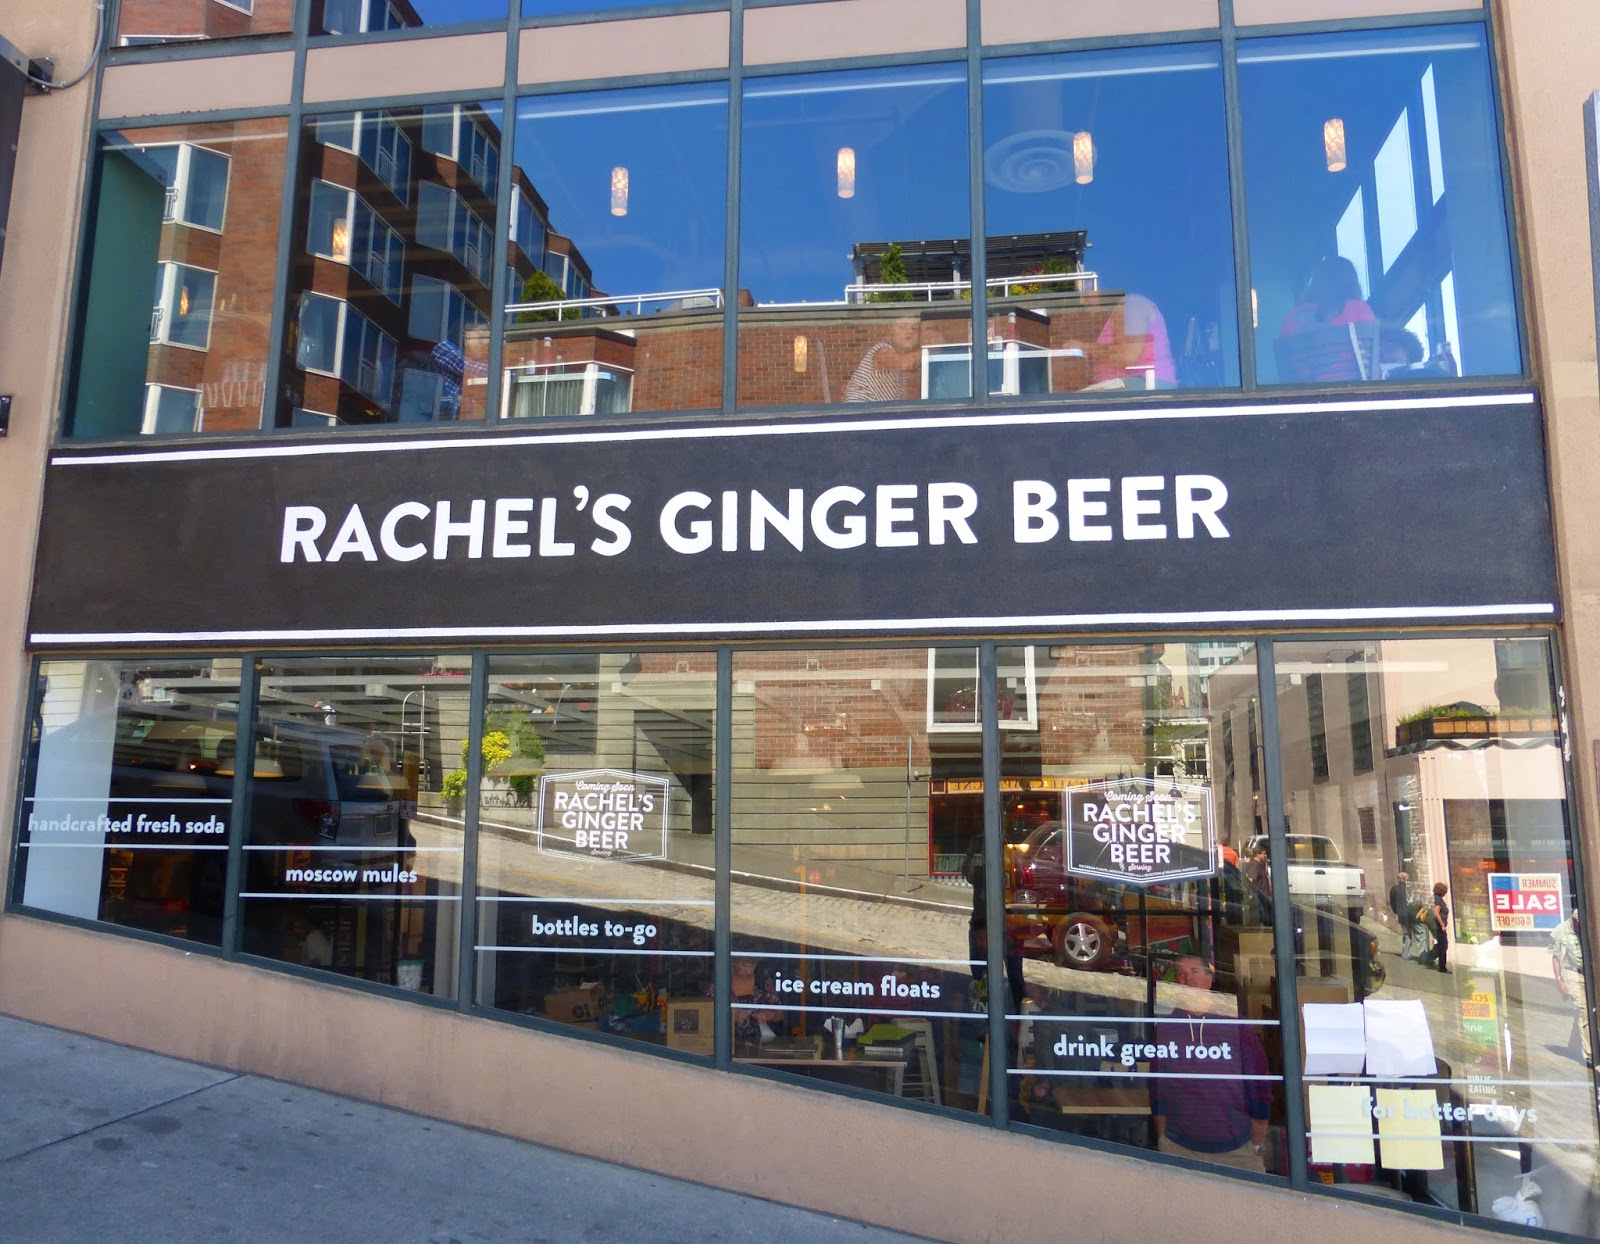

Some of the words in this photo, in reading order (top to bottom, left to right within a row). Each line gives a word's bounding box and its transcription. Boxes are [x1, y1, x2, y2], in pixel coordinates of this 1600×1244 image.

[280, 485, 632, 563] RACHEL'S
[659, 481, 979, 554] GINGER
[1012, 474, 1231, 543] BEER
[575, 780, 611, 793] Coming
[611, 781, 636, 793] Soon
[1104, 791, 1144, 803] Coming
[1145, 791, 1172, 803] Soon
[554, 791, 654, 812] RACHEL'S
[562, 811, 644, 831] GINGER
[1083, 802, 1196, 824] RACHEL'S
[28, 813, 132, 833] handcrafted
[136, 813, 181, 833] fresh
[186, 814, 225, 835] soda
[1092, 823, 1187, 844] GINGER
[575, 830, 629, 850] BEER
[1110, 843, 1171, 864] BEER
[286, 868, 358, 884] moscow
[363, 864, 418, 884] mules
[1128, 862, 1153, 872] Serving
[531, 915, 599, 937] bottles
[605, 917, 657, 945] to-go
[775, 972, 804, 993] ice
[810, 977, 874, 996] cream
[881, 975, 941, 999] floats
[1053, 1034, 1115, 1059] drink
[1121, 1040, 1179, 1066] great
[1186, 1041, 1232, 1061] root
[1363, 1096, 1394, 1120] for
[1403, 1096, 1474, 1122] better
[1484, 1099, 1537, 1131] days
